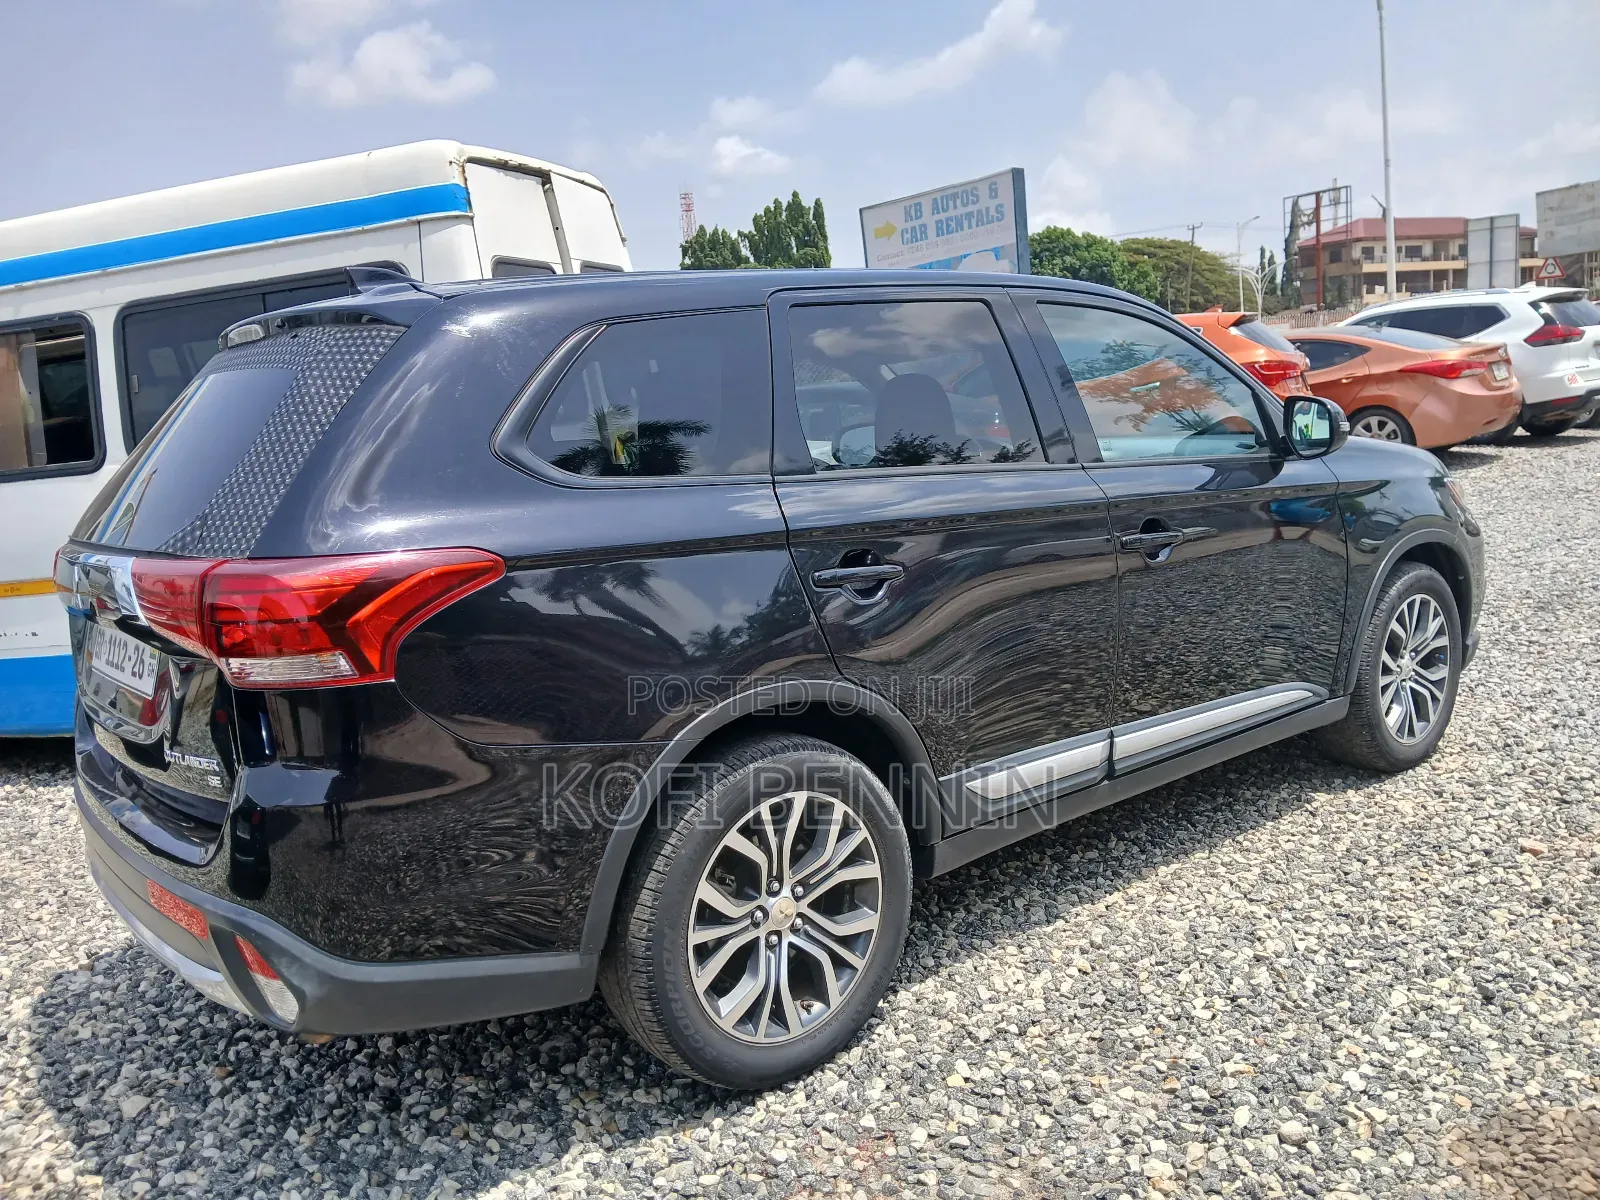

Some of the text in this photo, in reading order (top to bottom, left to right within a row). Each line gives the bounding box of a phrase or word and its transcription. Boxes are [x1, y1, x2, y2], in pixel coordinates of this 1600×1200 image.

[903, 181, 999, 223] KB AUTOS &
[900, 223, 929, 246] CAR
[935, 203, 1005, 238] RENTALS
[207, 774, 222, 788] SE
